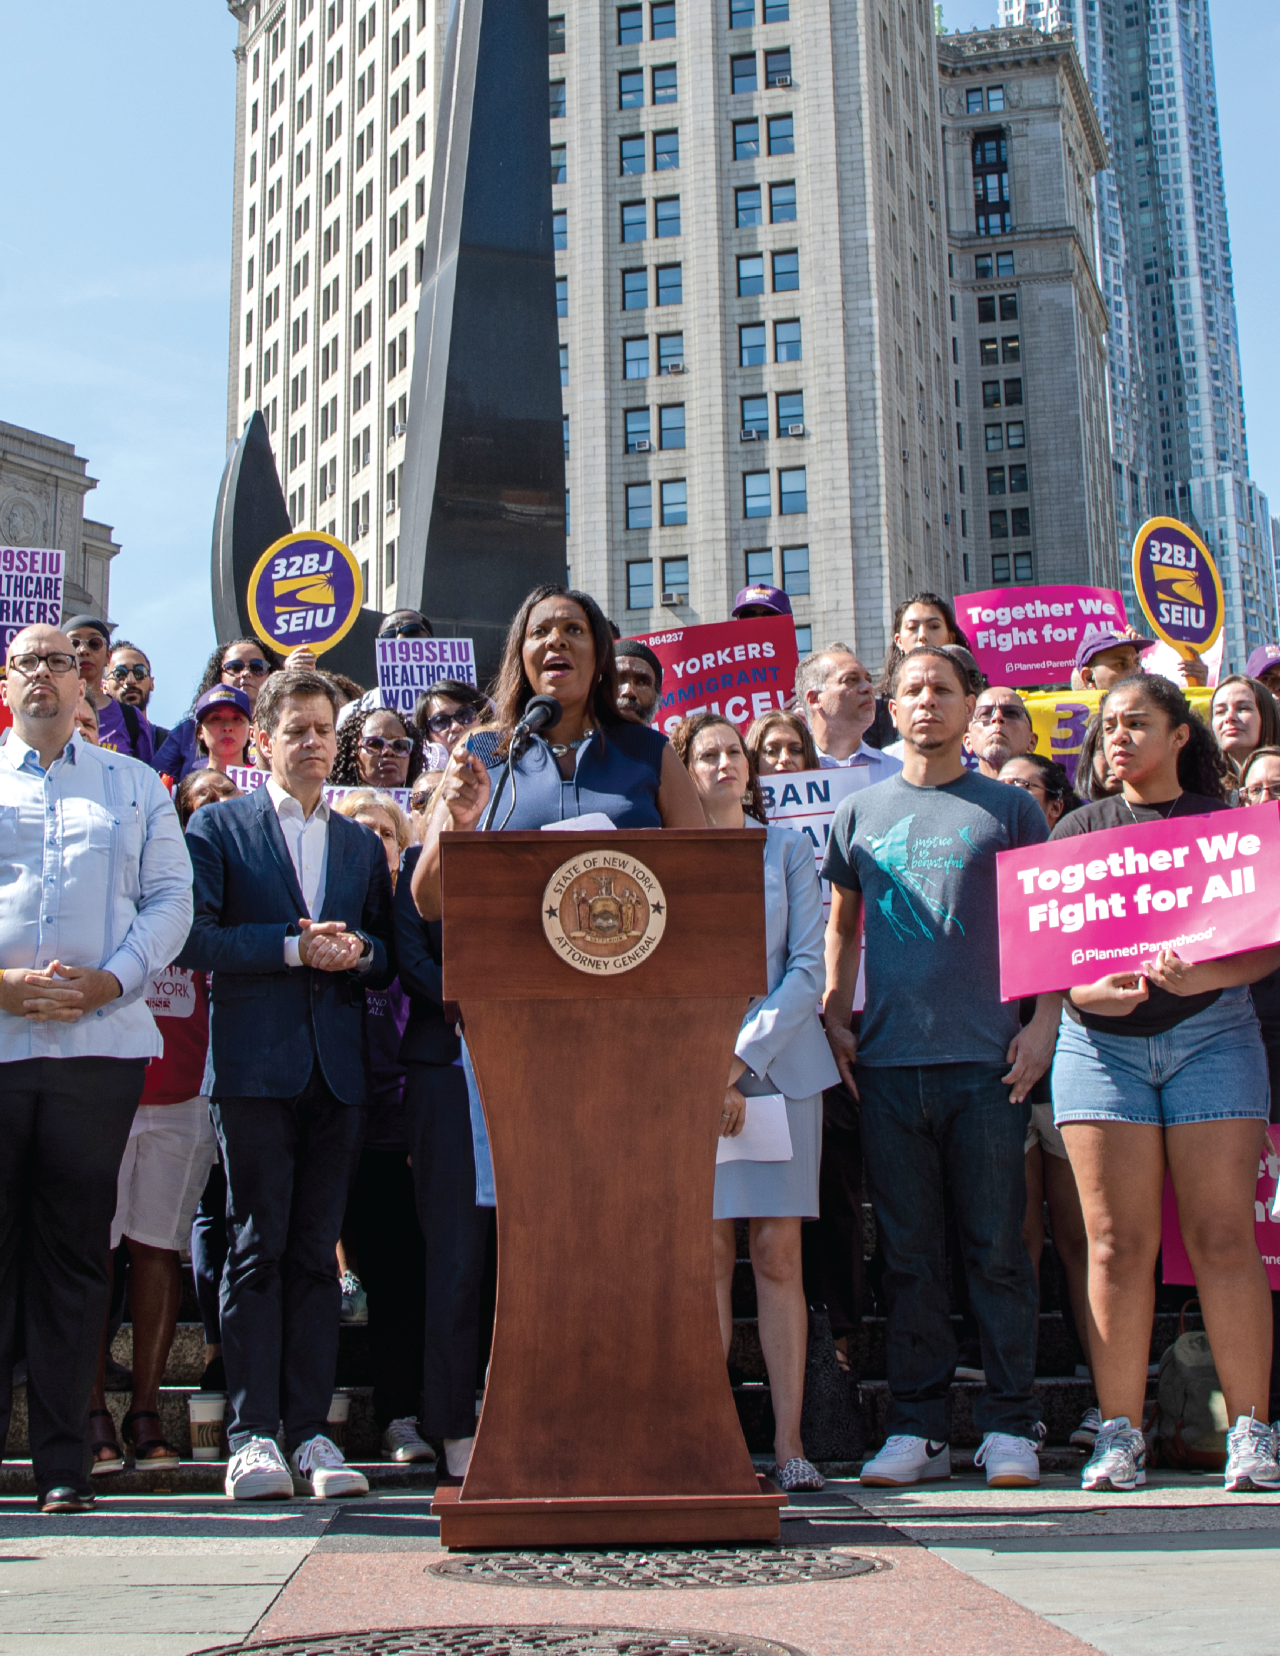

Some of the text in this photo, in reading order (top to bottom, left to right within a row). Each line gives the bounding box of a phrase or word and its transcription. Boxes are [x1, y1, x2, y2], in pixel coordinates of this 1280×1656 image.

[0, 549, 61, 575] 9SEIU
[271, 550, 334, 580] 32BJ
[1149, 540, 1197, 568] 32BJ
[274, 606, 336, 635] SEIU
[967, 599, 1116, 626] Together We
[1159, 603, 1206, 629] SEIU
[378, 641, 470, 663] 1199SEIU
[649, 631, 684, 647] 864237
[976, 626, 1038, 652] Fight
[1042, 624, 1077, 643] for
[672, 642, 776, 679] YORKERS
[1014, 660, 1046, 671] Planned
[659, 666, 780, 709] MMIGRANT
[911, 836, 953, 852] justice
[919, 848, 930, 859] is
[553, 857, 656, 895] STATE OF NEW YORK
[911, 853, 963, 875] beautiful
[1017, 831, 1261, 895] Together We
[1028, 866, 1256, 933] Fight for All
[555, 936, 656, 970] ATTORNEY GENERAL
[1086, 928, 1213, 961] Planned Parenthood
[153, 981, 190, 998] YORK
